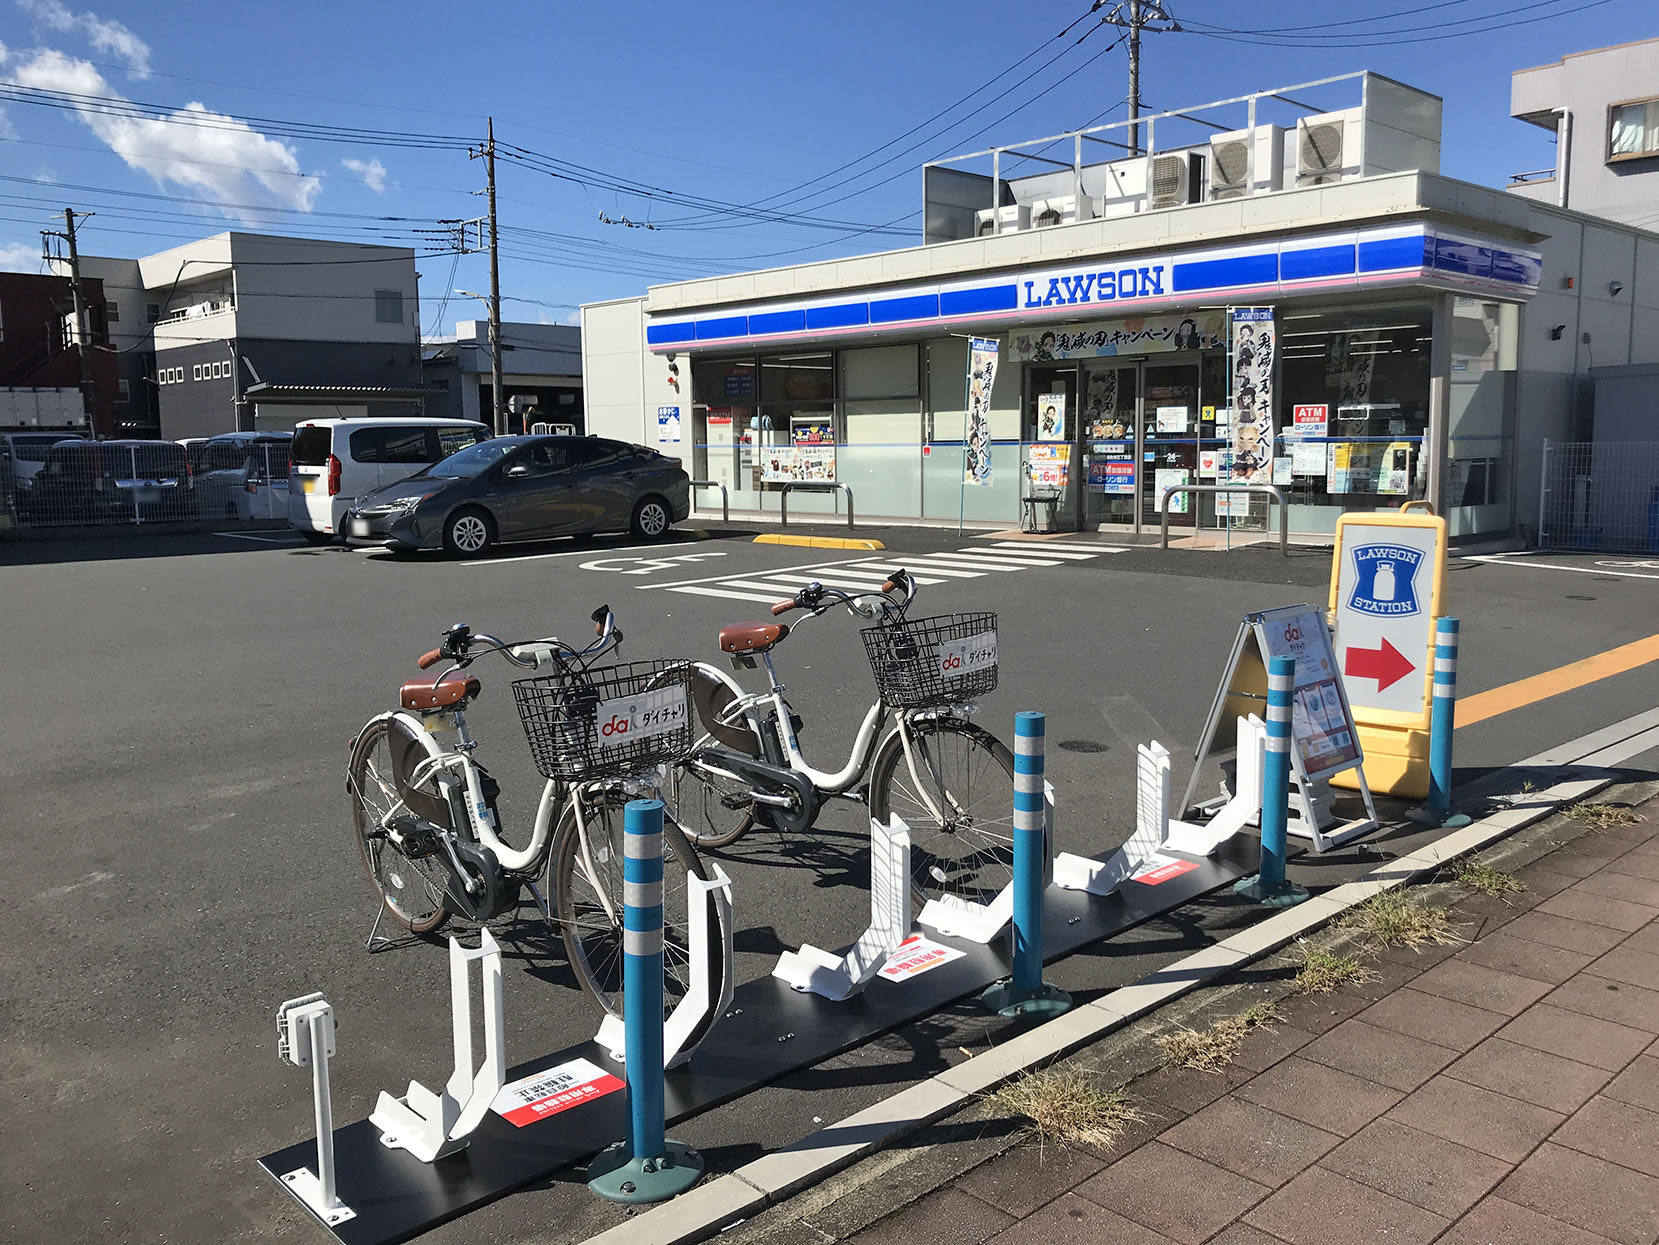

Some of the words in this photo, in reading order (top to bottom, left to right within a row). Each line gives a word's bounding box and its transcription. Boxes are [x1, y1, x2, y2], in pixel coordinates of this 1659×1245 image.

[1024, 265, 1164, 308] LAWSON
[1233, 311, 1273, 321] LAWSON
[1298, 407, 1322, 417] ATM
[1357, 549, 1418, 564] LAWSON
[1354, 596, 1412, 613] STATION
[968, 646, 996, 664] ダイチャリ
[642, 703, 685, 727] ダイチャリ
